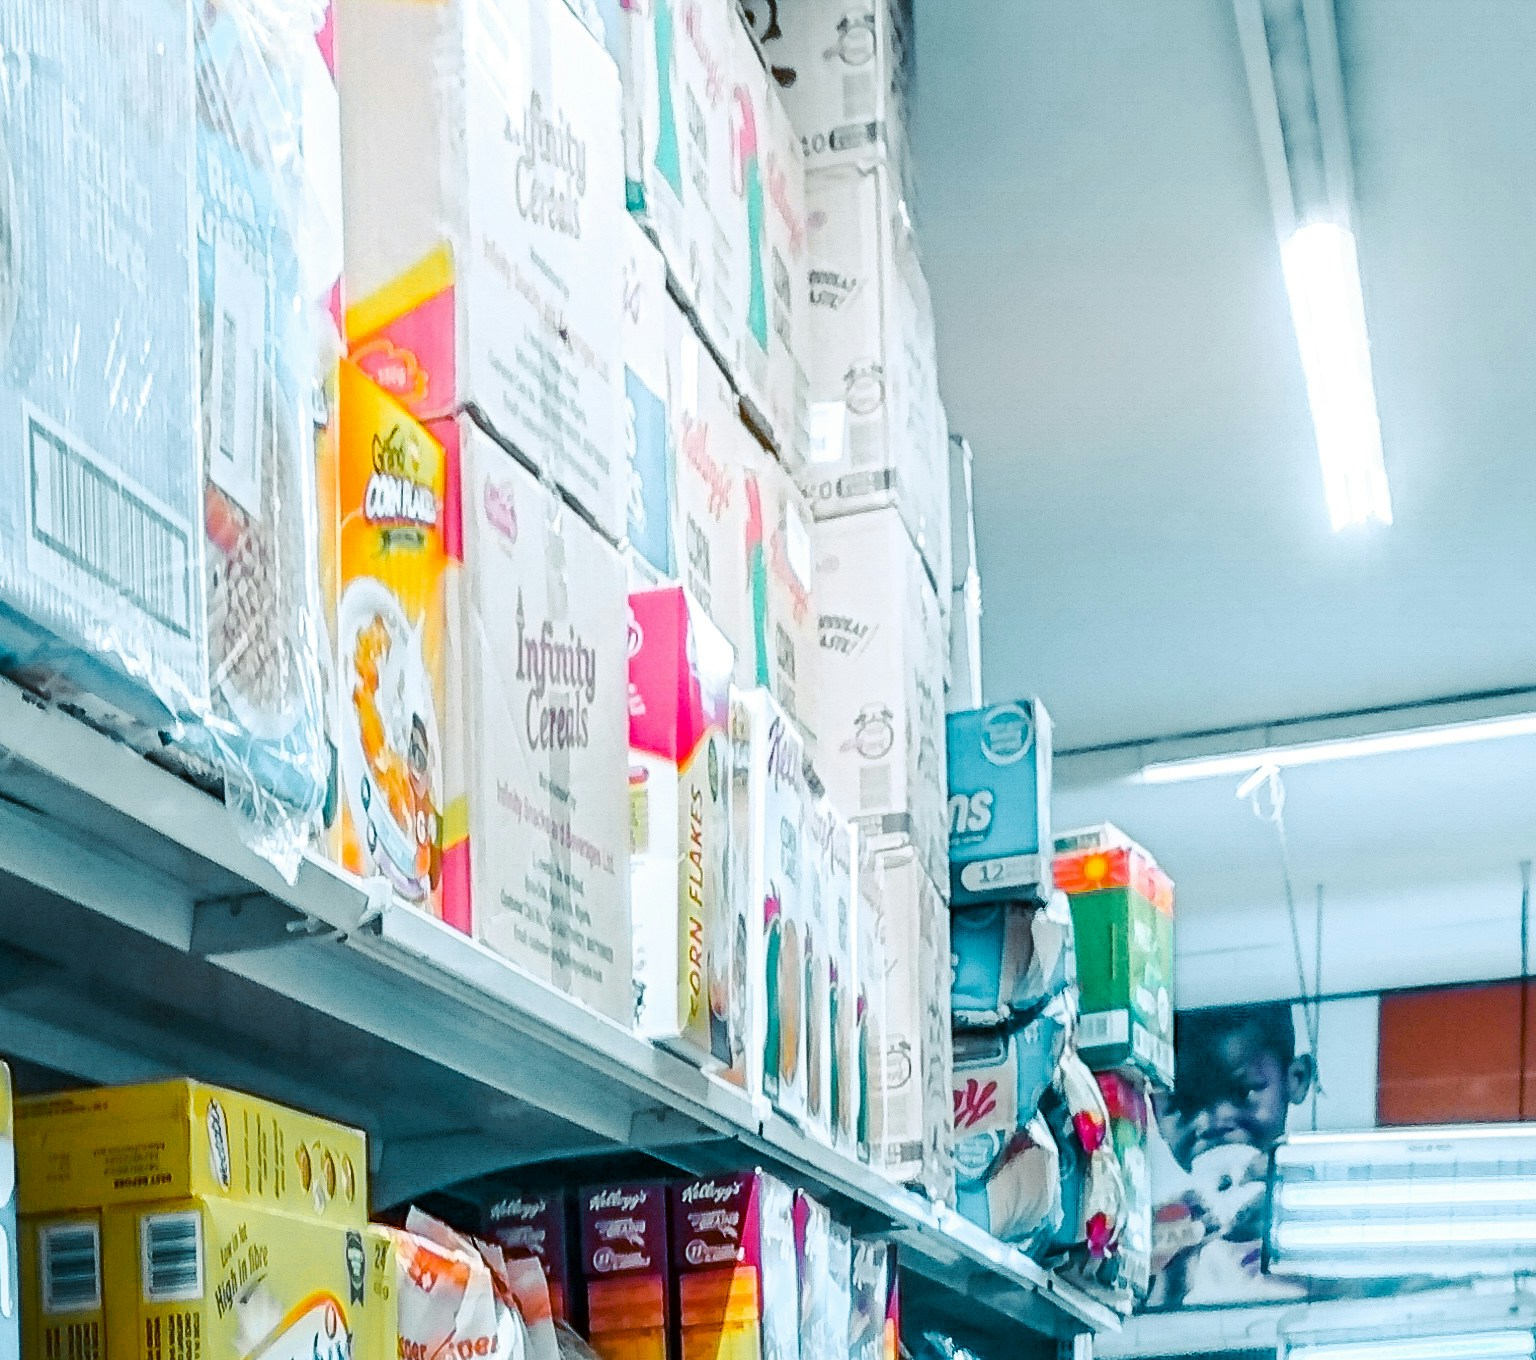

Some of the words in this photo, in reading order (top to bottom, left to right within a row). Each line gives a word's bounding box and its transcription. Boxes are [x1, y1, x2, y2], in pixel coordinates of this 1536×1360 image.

[514, 586, 597, 690] Infinity
[524, 698, 590, 752] Cereals
[686, 784, 705, 909] FLAKES
[978, 860, 1005, 884] 12
[589, 1188, 648, 1212] Kellogg's
[681, 1179, 744, 1204] Kellogg's
[215, 1266, 239, 1320] High
[238, 1256, 249, 1282] in
